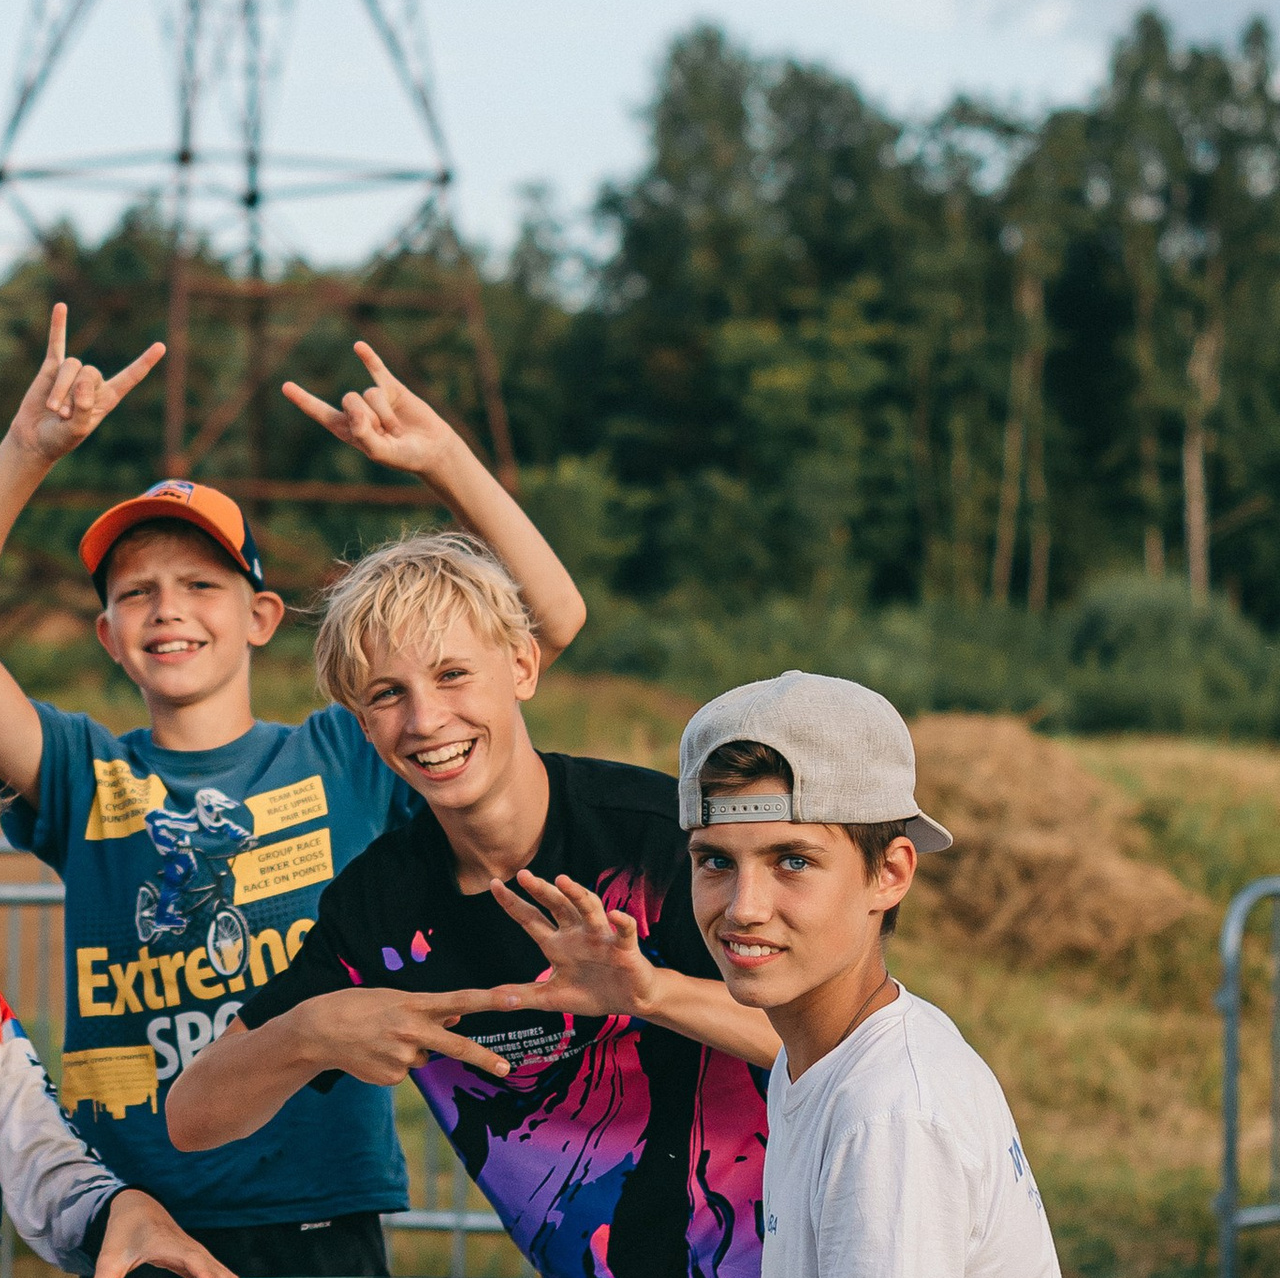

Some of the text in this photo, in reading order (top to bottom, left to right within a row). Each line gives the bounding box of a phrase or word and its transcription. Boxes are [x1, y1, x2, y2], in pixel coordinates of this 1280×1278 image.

[268, 782, 316, 804] TEAM RACE
[266, 794, 319, 816] RACE UPHILL
[280, 803, 322, 823] PAIR RACE
[257, 837, 322, 863] GROUP RACE
[259, 850, 325, 876] BIKER CROSS
[243, 862, 328, 893] RACE ON POINTS
[507, 1026, 544, 1041] REQUIRES
